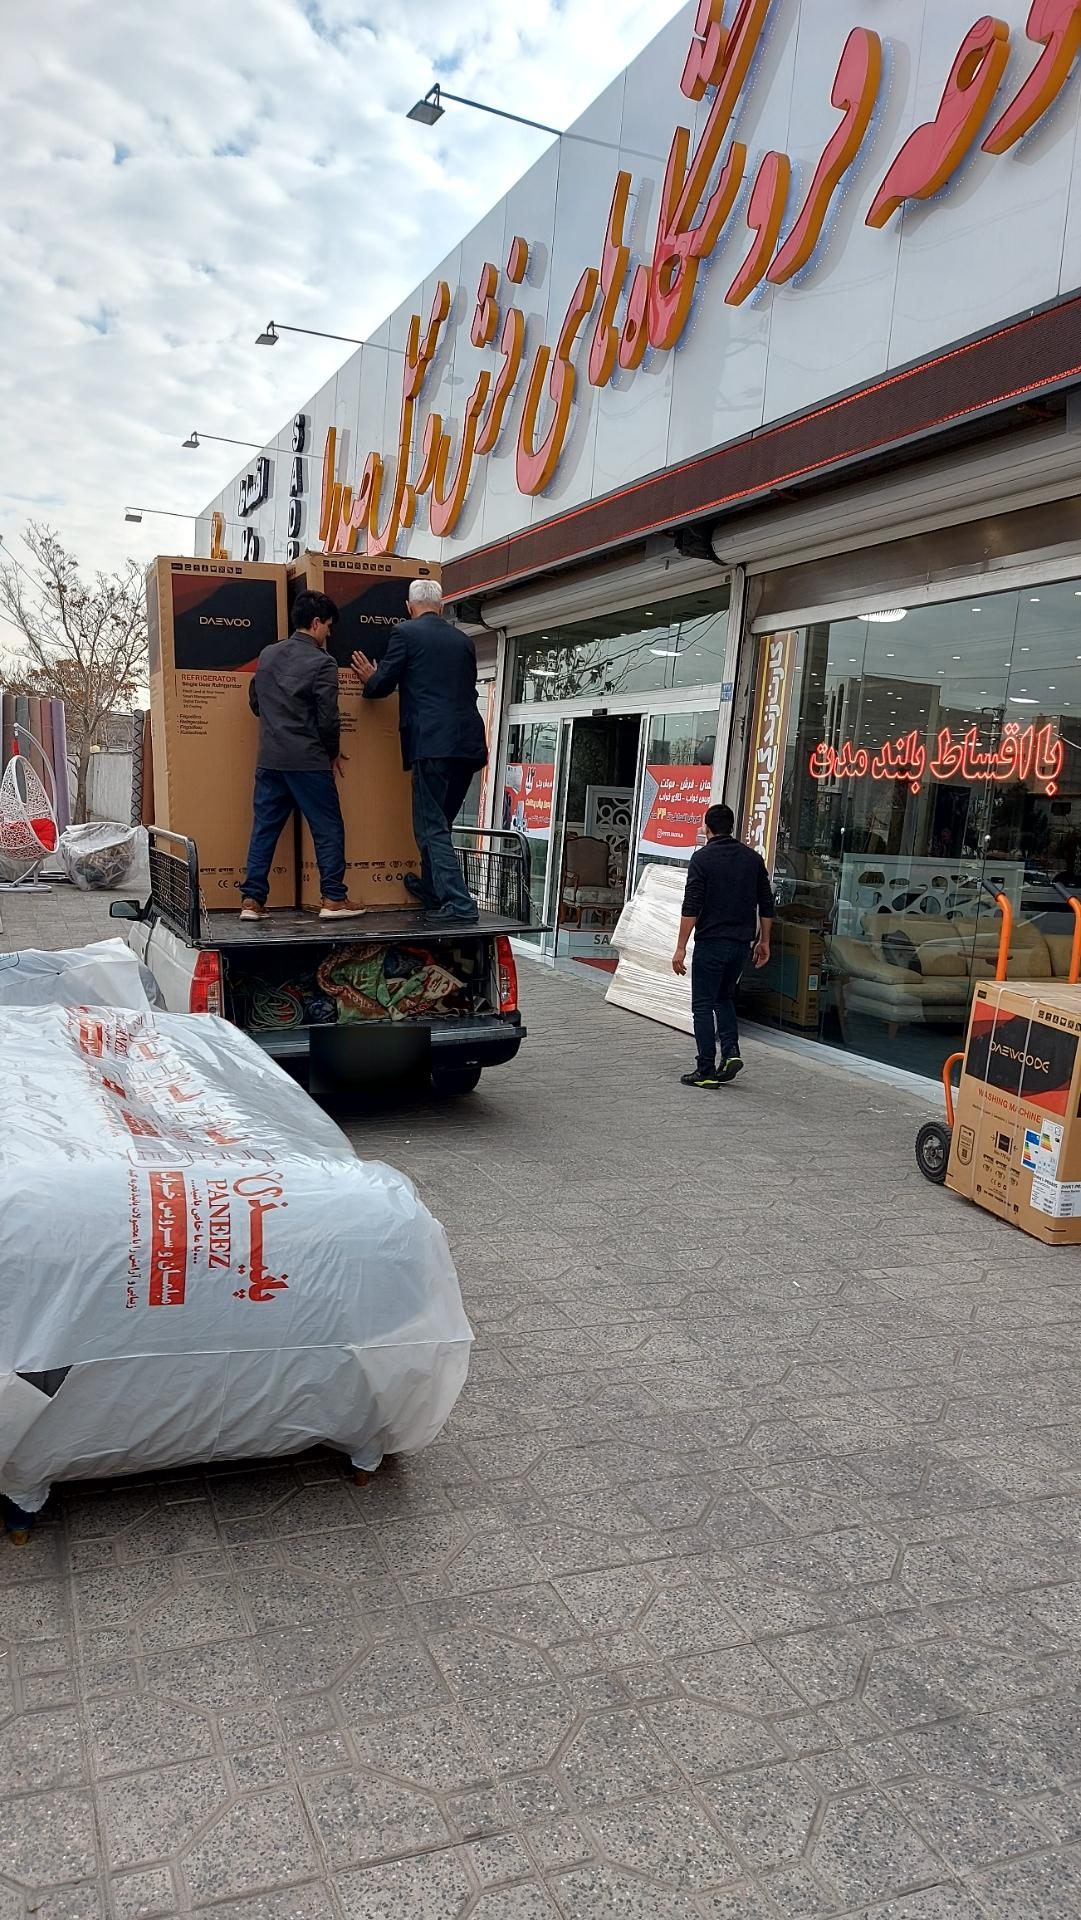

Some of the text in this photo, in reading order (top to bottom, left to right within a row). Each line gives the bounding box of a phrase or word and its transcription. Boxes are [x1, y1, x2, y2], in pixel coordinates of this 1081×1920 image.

[430, 237, 528, 538] فرش
[415, 414, 443, 495] و
[286, 413, 306, 563] SADR
[199, 616, 251, 628] DAEWOO
[181, 674, 237, 683] REFRIGERATOR
[753, 641, 785, 862] کارت زندگی ایرانخو
[808, 722, 1064, 796] با اقساط بلند مدت
[593, 934, 610, 945] SA
[990, 1041, 1034, 1066] DAEWOO
[978, 1088, 1008, 1109] WASHING
[156, 1172, 182, 1200] خواب
[158, 1201, 177, 1247] سرویس
[191, 1208, 204, 1228] خاص
[206, 1178, 231, 1269] PANEEZ
[232, 1199, 290, 1302] پانیذ
[157, 1260, 182, 1304] مبلمان
